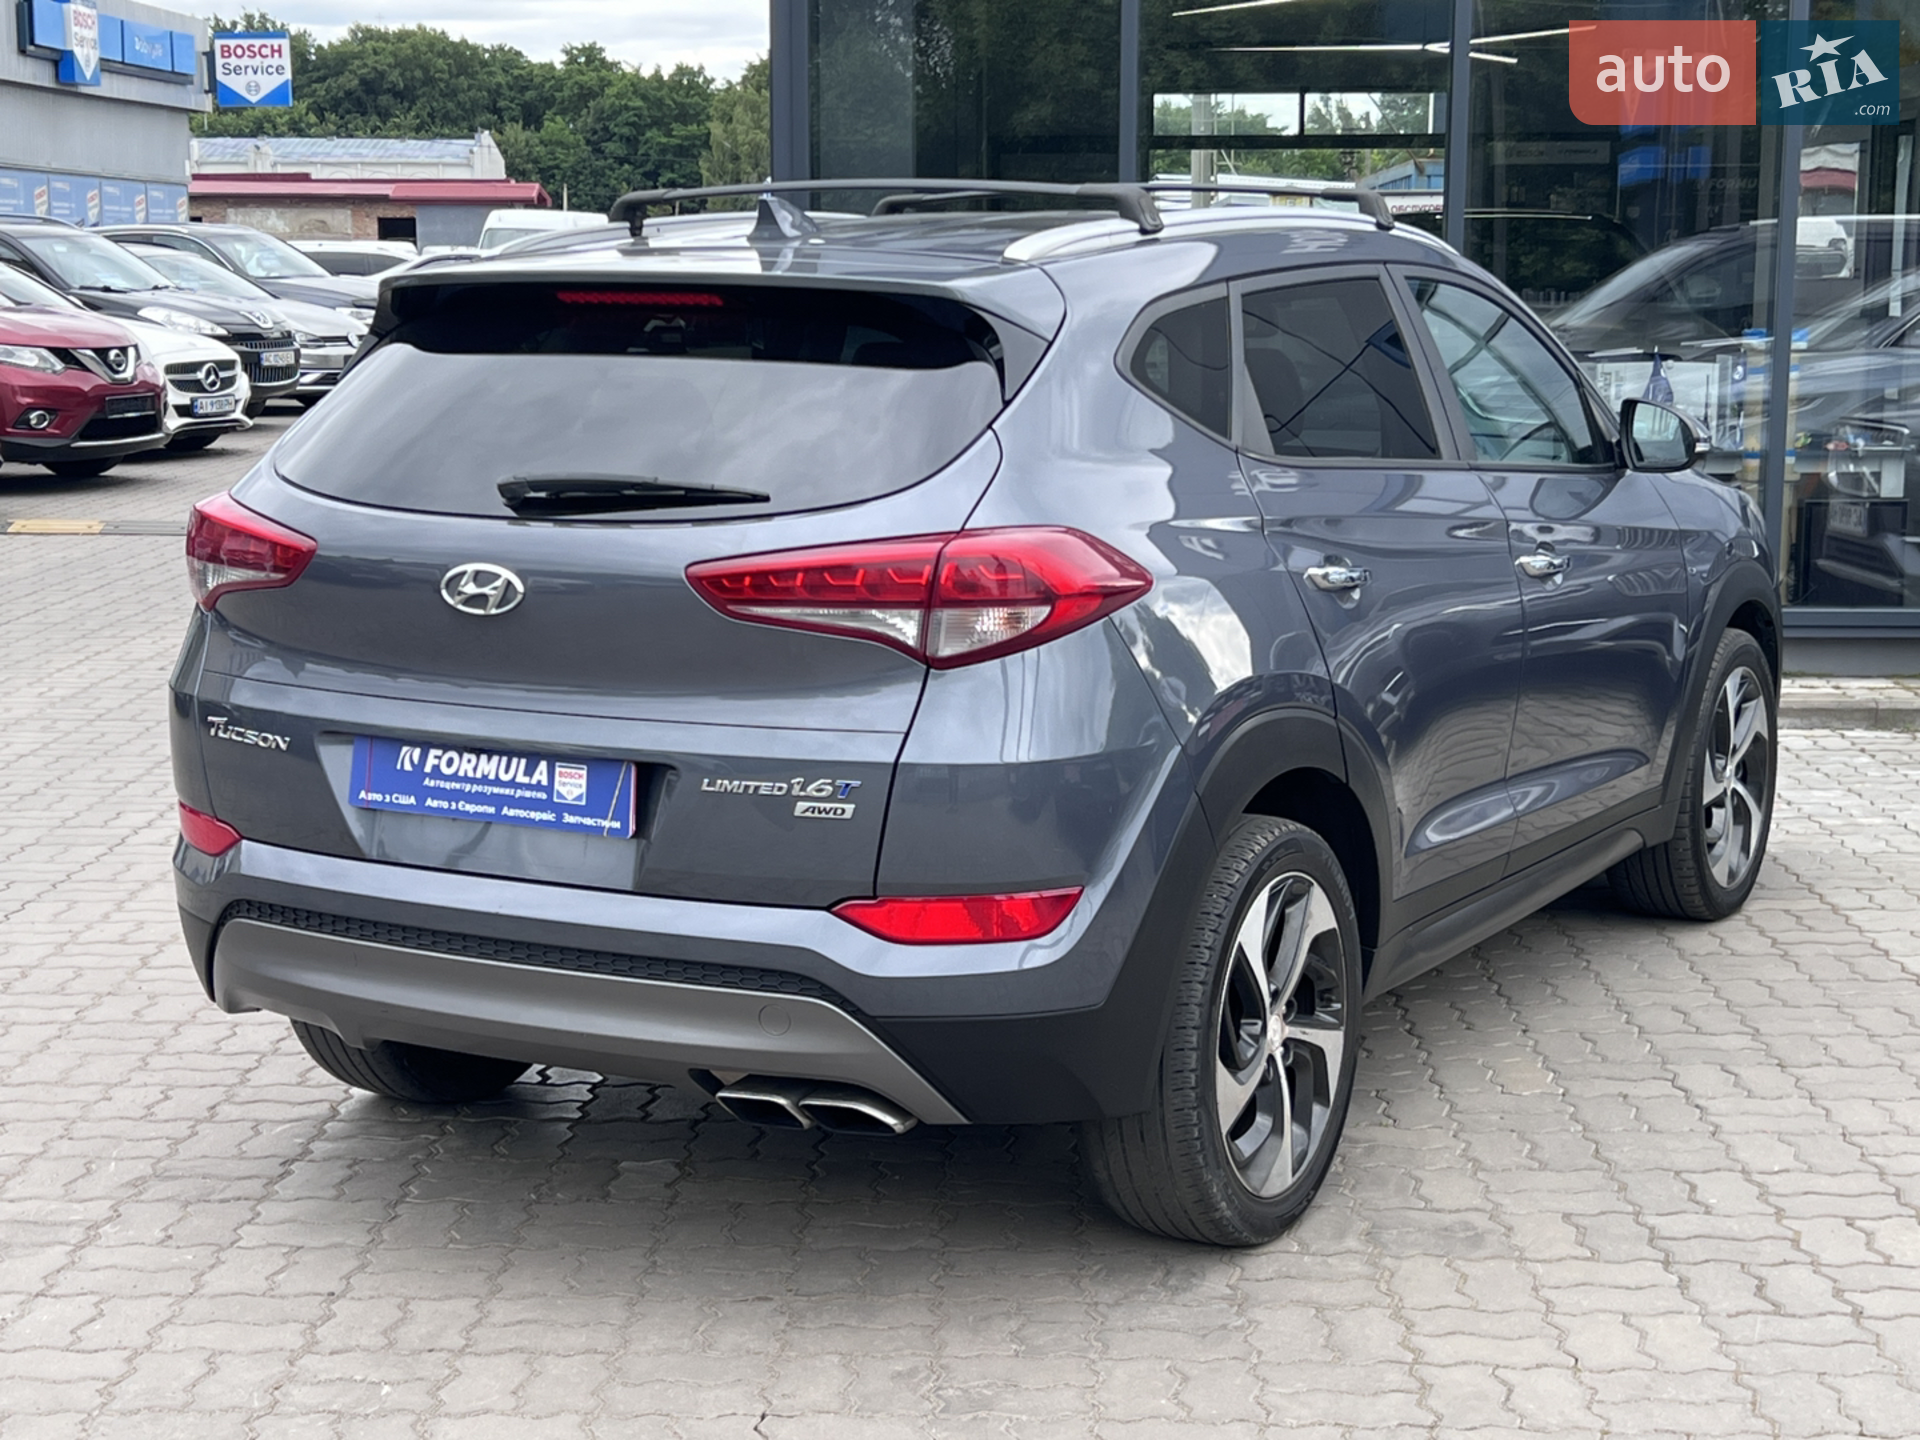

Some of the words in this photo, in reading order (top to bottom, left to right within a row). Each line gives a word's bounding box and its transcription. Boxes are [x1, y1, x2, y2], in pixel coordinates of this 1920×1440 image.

[220, 43, 282, 59] BOSCH
[221, 61, 285, 76] Service
[423, 748, 549, 786] FORMULA
[558, 770, 584, 779] BOSCH
[423, 777, 471, 792] Автоцентр
[471, 783, 515, 795] розумних
[515, 788, 548, 800] рішень
[558, 779, 583, 788] Service
[701, 778, 788, 796] LIMITED
[358, 789, 383, 802] Авто
[384, 794, 390, 803] з
[391, 793, 416, 805] США
[424, 797, 449, 809] Авто
[450, 801, 456, 810] з
[458, 801, 496, 814] Європи
[501, 806, 556, 821] Автосервіс
[562, 813, 621, 829] Запчастини
[801, 806, 846, 817] AWD
